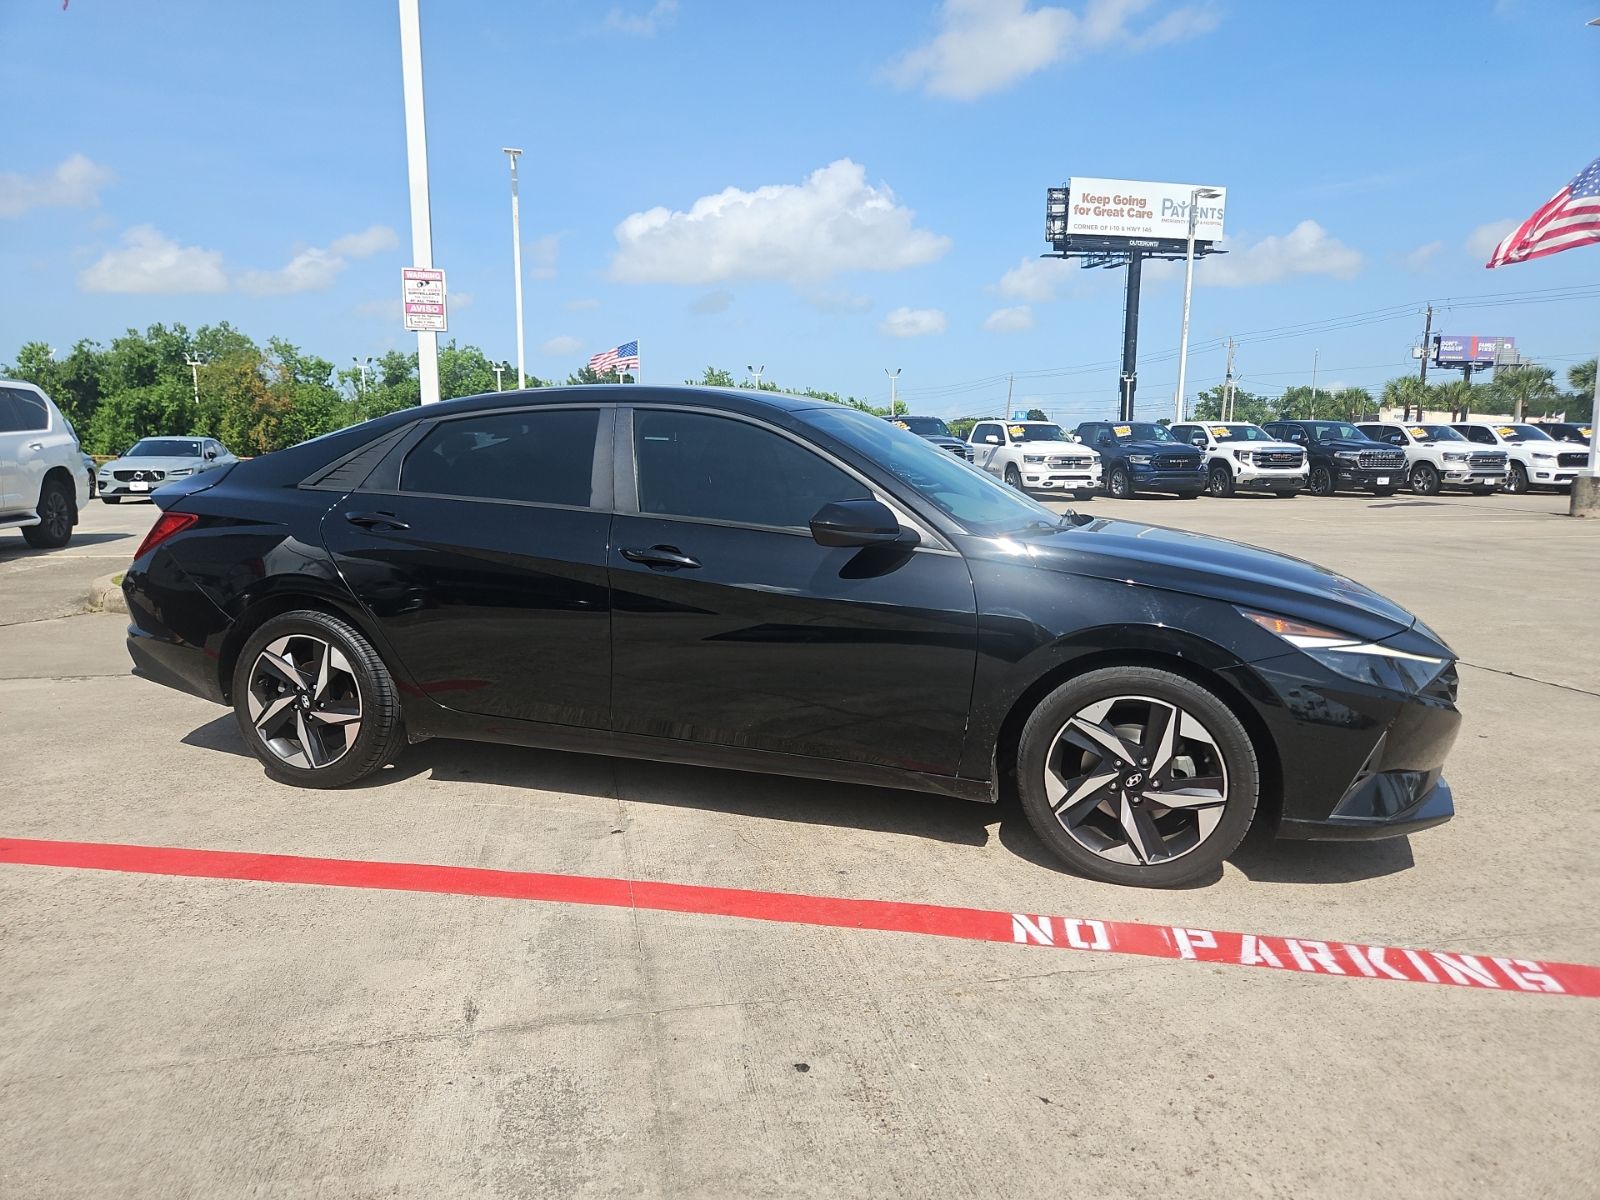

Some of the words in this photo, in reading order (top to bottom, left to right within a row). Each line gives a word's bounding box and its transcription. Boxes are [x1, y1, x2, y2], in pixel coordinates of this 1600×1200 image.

[1081, 192, 1110, 206] Keep
[1113, 195, 1147, 208] Going
[1073, 205, 1091, 215] for
[1093, 207, 1125, 217] Great
[1127, 208, 1153, 218] Care
[410, 305, 439, 313] AVISO
[1011, 914, 1111, 951] NO
[1171, 927, 1567, 993] PARKING
